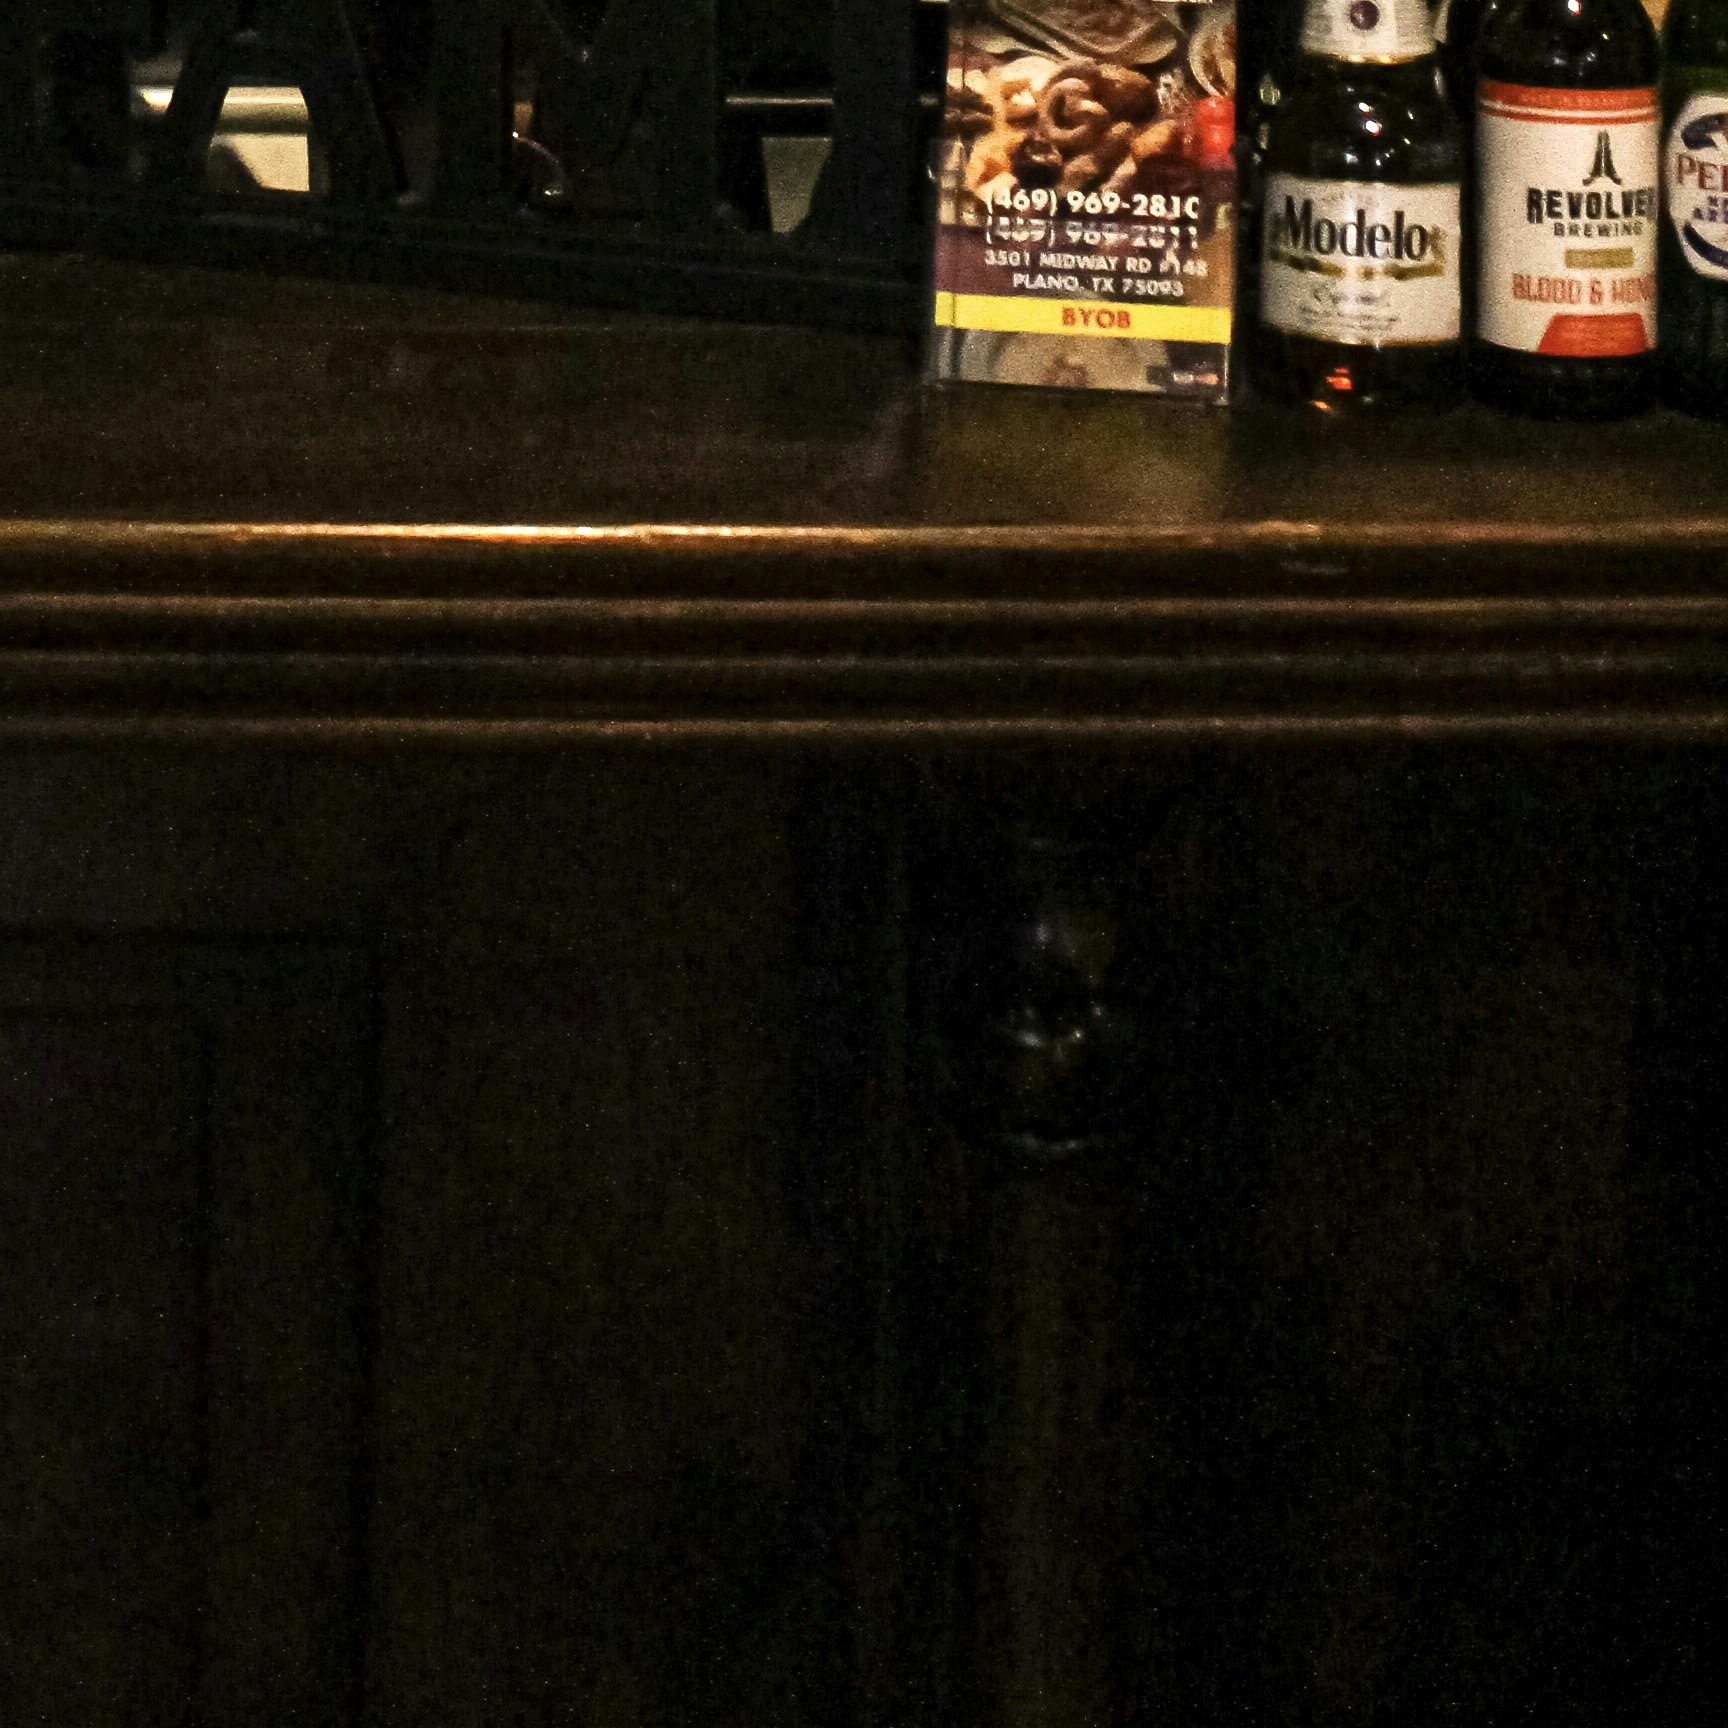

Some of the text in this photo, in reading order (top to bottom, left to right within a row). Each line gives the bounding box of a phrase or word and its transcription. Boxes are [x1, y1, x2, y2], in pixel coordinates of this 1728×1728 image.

[985, 188, 1057, 217] (469)
[1284, 194, 1430, 262] Modelo
[1553, 222, 1643, 239] BREWING
[984, 249, 1029, 267] 3501
[1039, 251, 1118, 272] MIDWAY
[1125, 256, 1152, 274] RD
[1092, 277, 1114, 293] TX
[1062, 307, 1132, 330] BYOB
